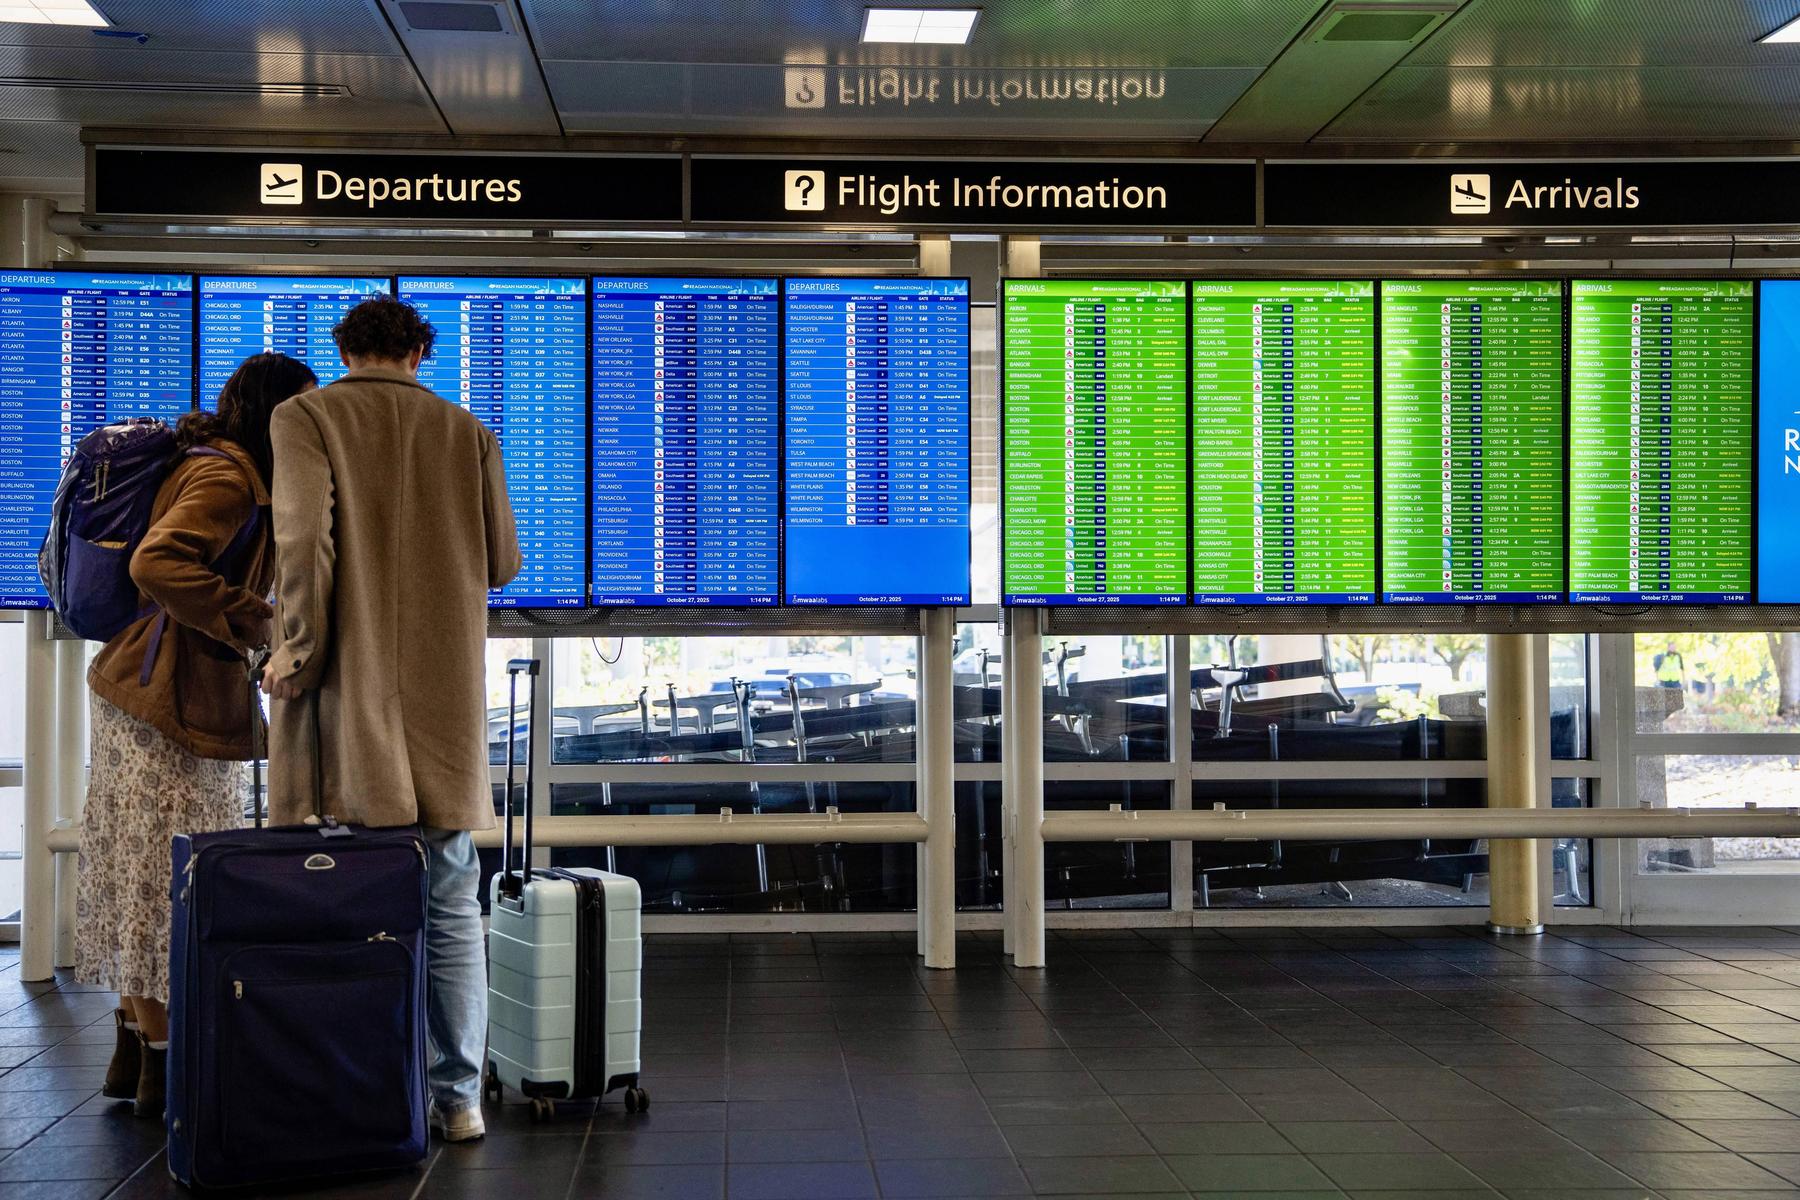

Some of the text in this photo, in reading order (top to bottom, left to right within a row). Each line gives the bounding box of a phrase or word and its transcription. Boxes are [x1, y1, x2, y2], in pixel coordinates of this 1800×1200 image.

[317, 169, 522, 209] Departures
[1505, 177, 1640, 209] Arrivals
[838, 175, 1167, 215] Flight Information
[1, 275, 56, 285] DEPARTURES
[204, 280, 257, 290] DEPARTURES
[402, 281, 454, 290] DEPARTURES
[597, 281, 649, 290] DEPARTURES
[789, 283, 840, 291] DEPARTURES
[1008, 284, 1046, 293] ARRIVALS
[1196, 285, 1233, 293] ARRIVALS
[1385, 285, 1422, 293] ARRIVALS
[1576, 284, 1612, 292] ARRIVALS
[5, 598, 39, 606] mwaalabs
[493, 598, 503, 606] 27,
[797, 596, 828, 604] mwaalabs
[1287, 595, 1296, 603] 27,
[1476, 594, 1484, 602] 27,
[1580, 594, 1611, 602] mwaalabs
[1662, 594, 1671, 602] 27,
